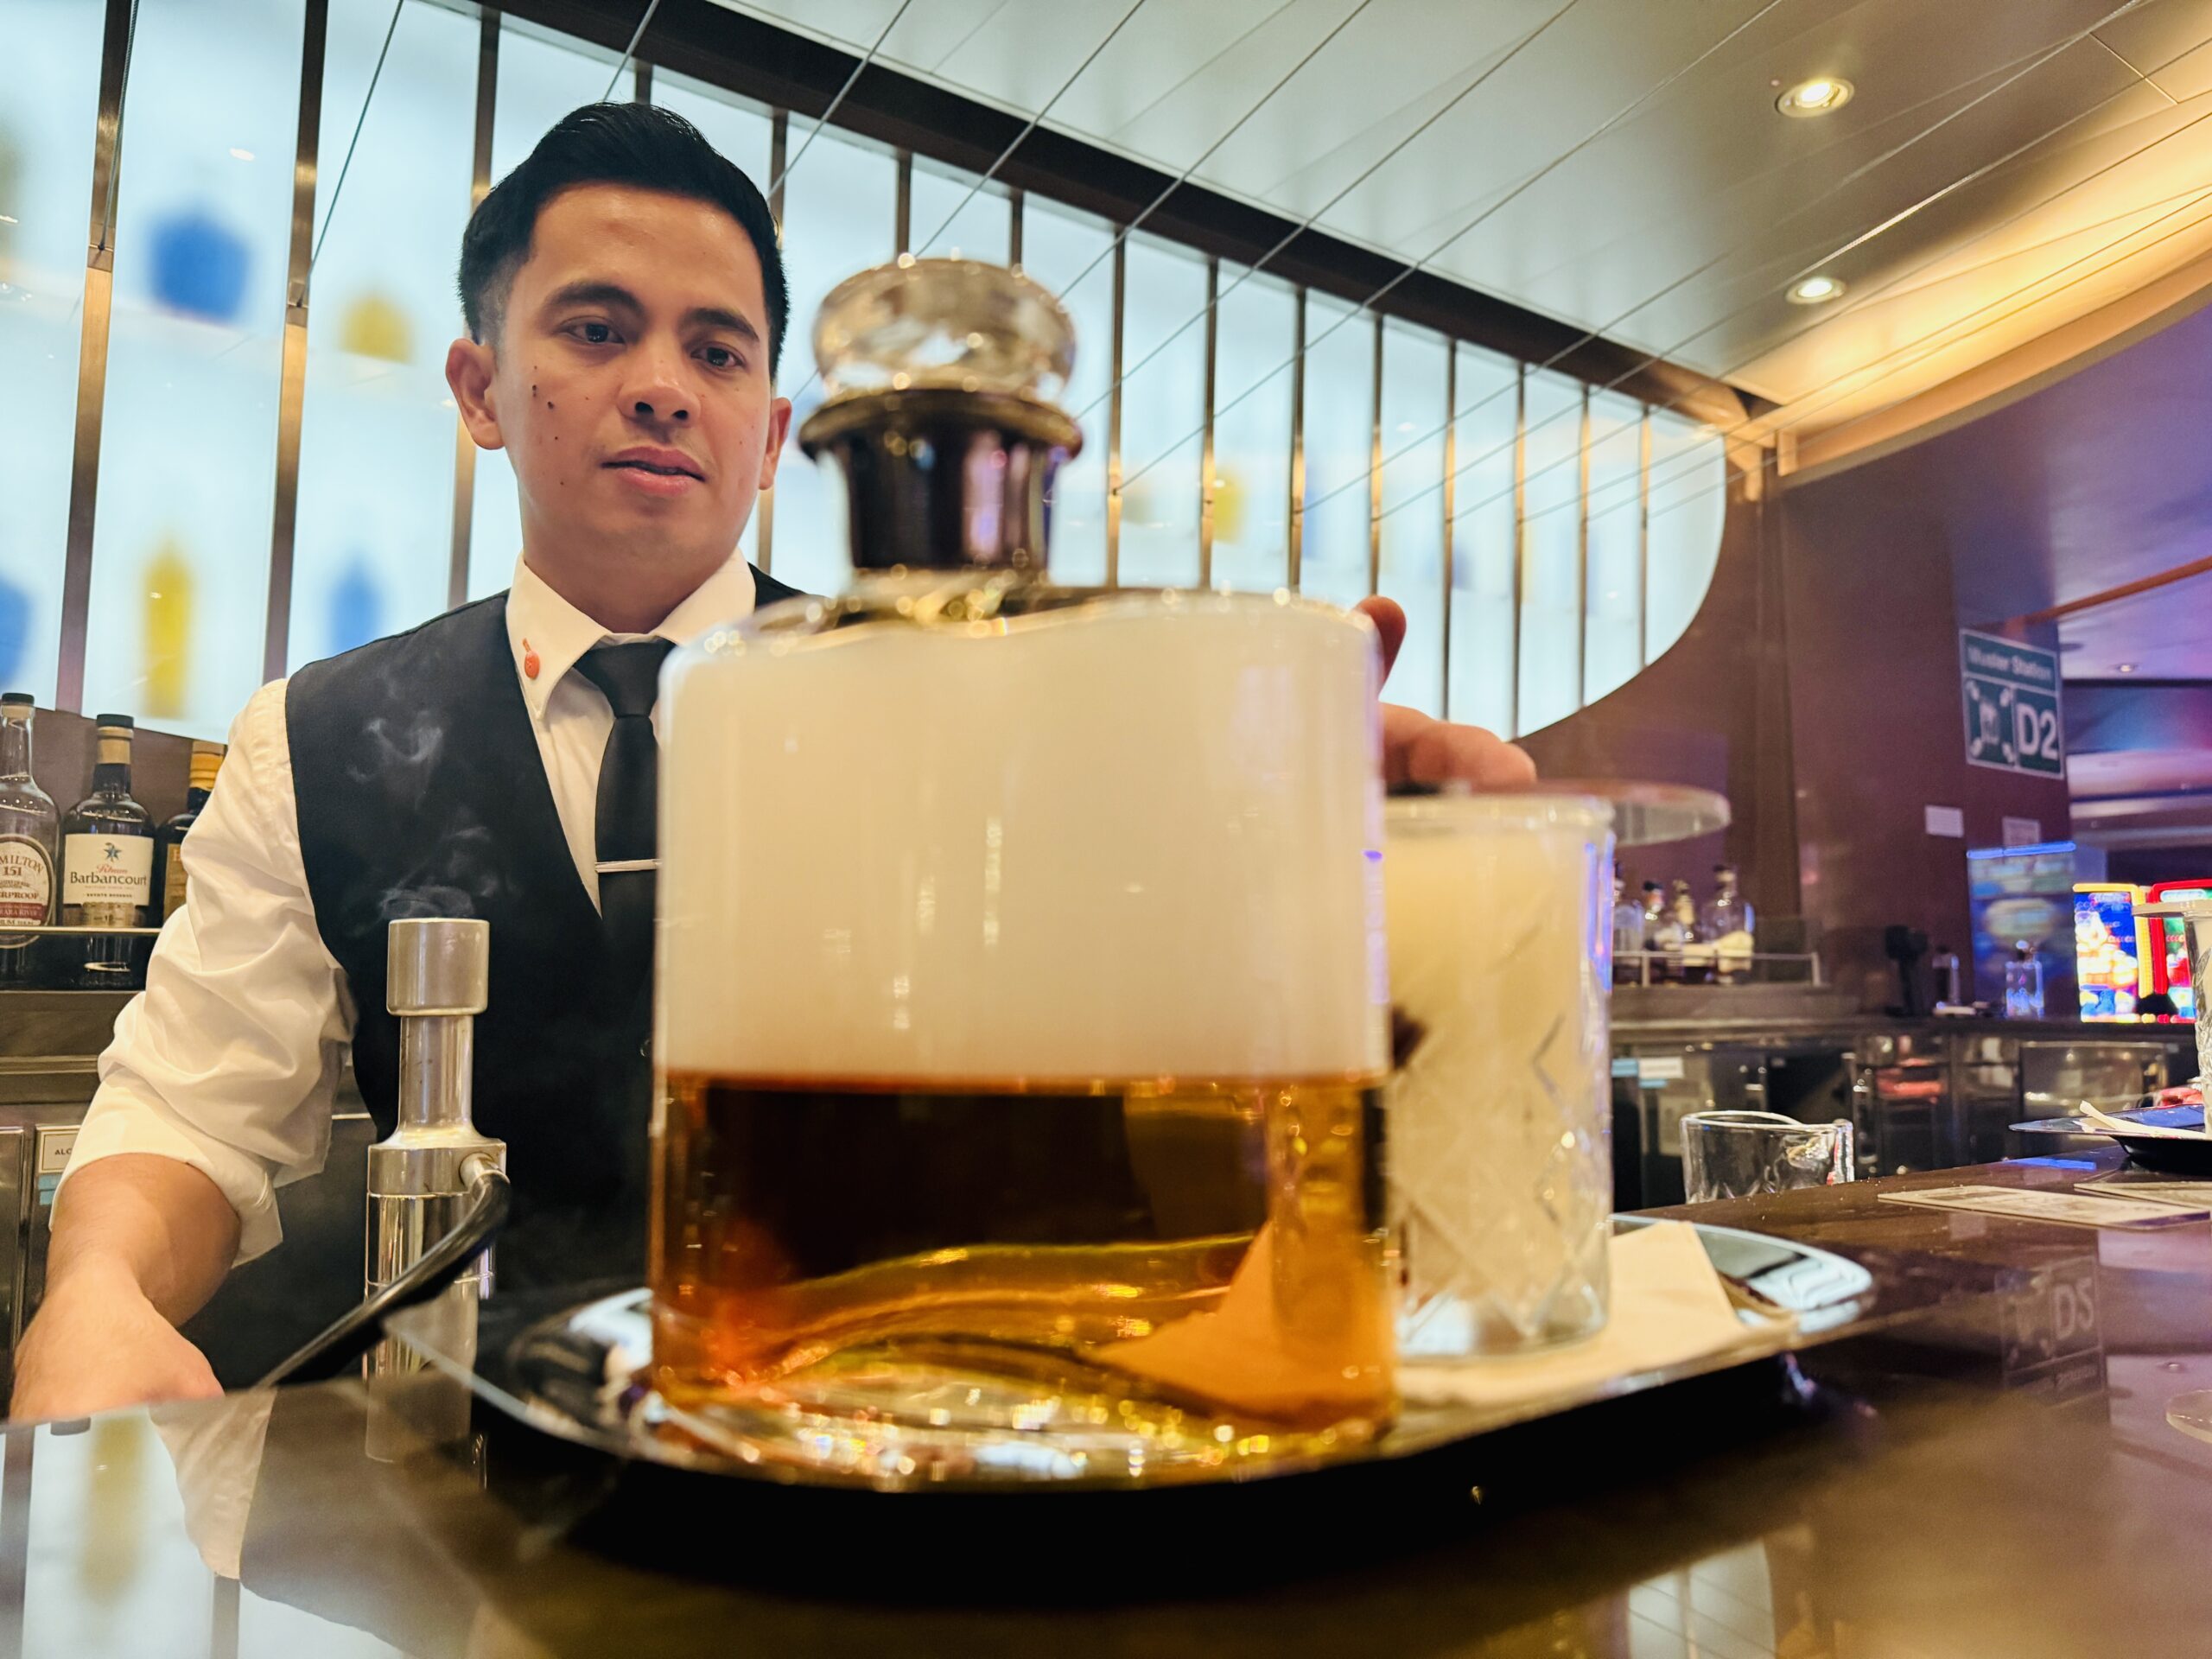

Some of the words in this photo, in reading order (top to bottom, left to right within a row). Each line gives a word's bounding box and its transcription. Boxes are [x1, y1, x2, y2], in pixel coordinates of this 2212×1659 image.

[2017, 702, 2059, 760] D2
[3, 866, 22, 876] 151
[70, 871, 147, 886] Barbancourt
